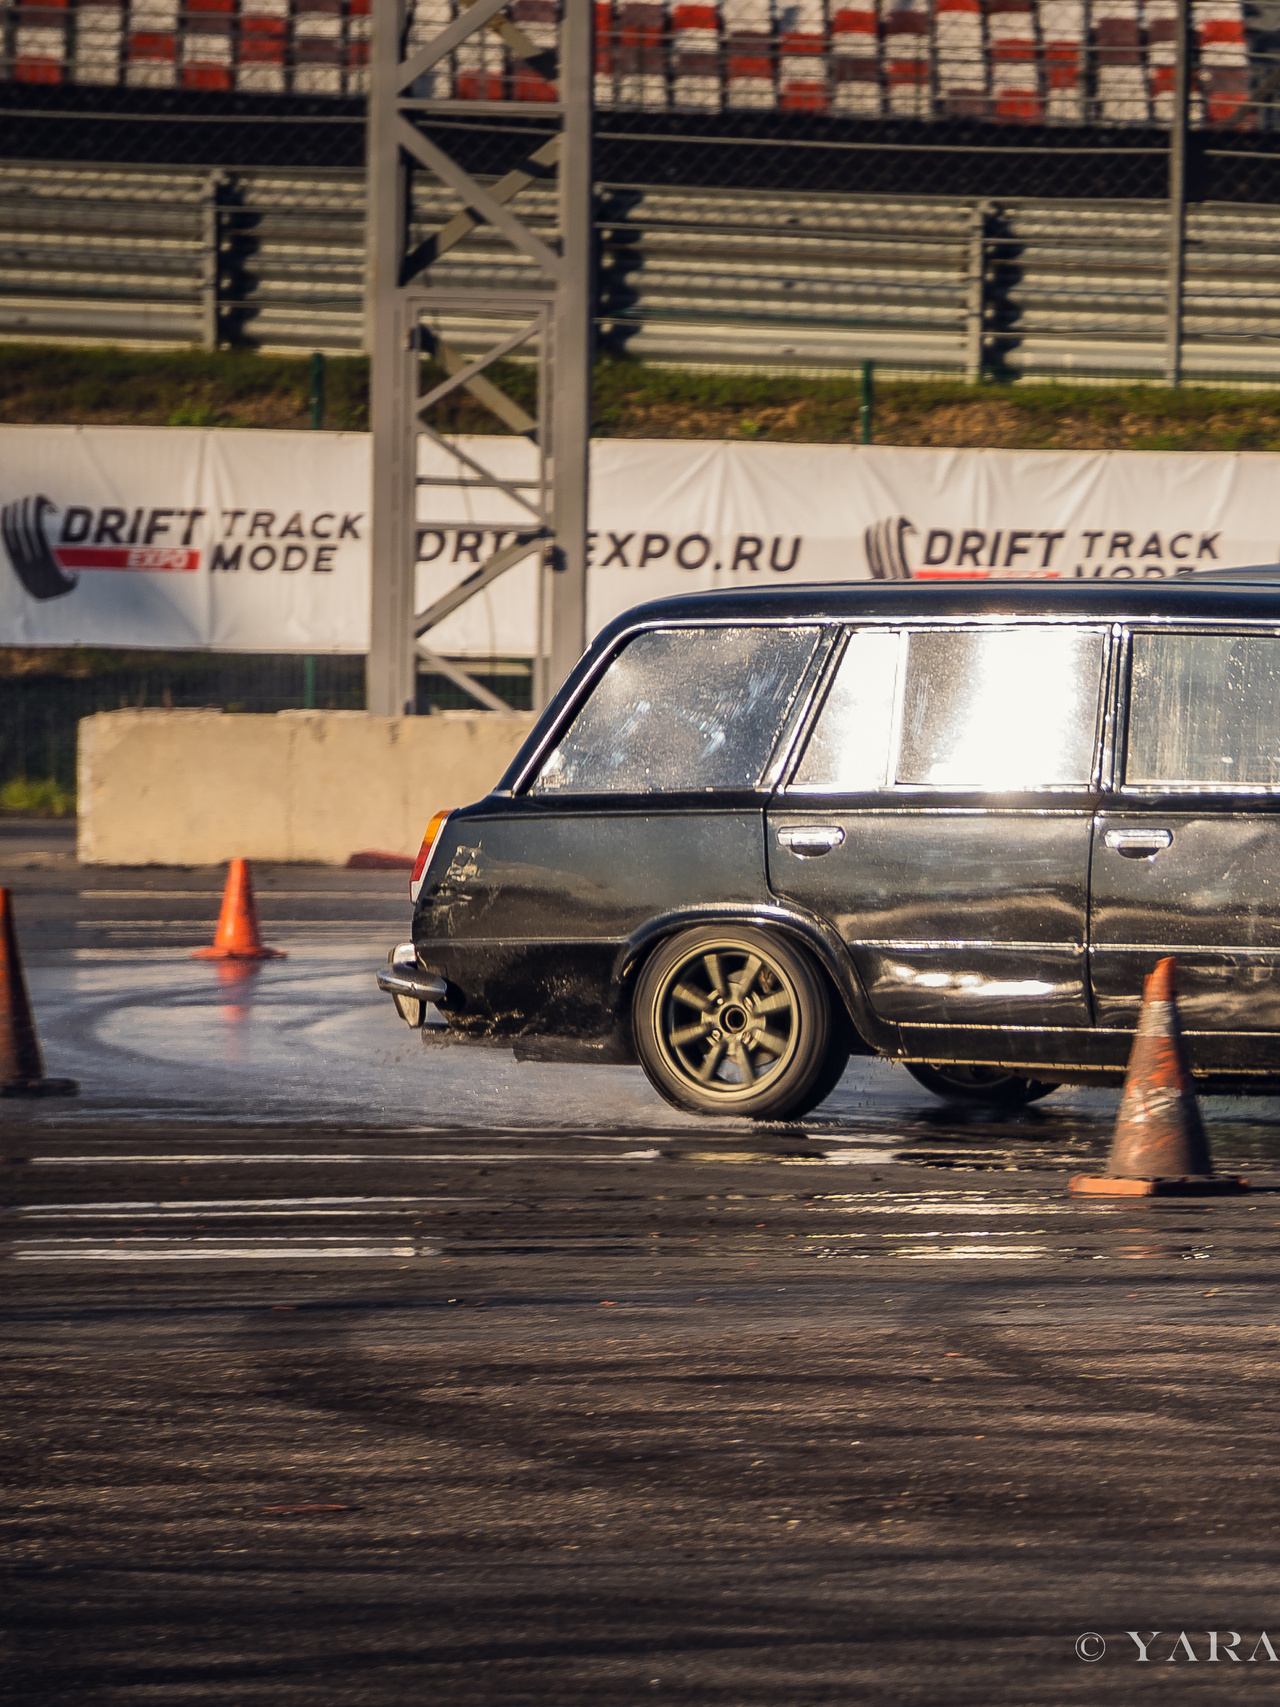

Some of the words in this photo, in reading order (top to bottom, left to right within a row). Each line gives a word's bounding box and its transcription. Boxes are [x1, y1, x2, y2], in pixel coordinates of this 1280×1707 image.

[61, 507, 206, 545] DRIFT
[221, 511, 366, 540] TRACK
[128, 551, 190, 569] EXPO
[209, 545, 338, 573] MODE
[922, 529, 1067, 567] DRIFT
[1082, 531, 1225, 560] TRACK
